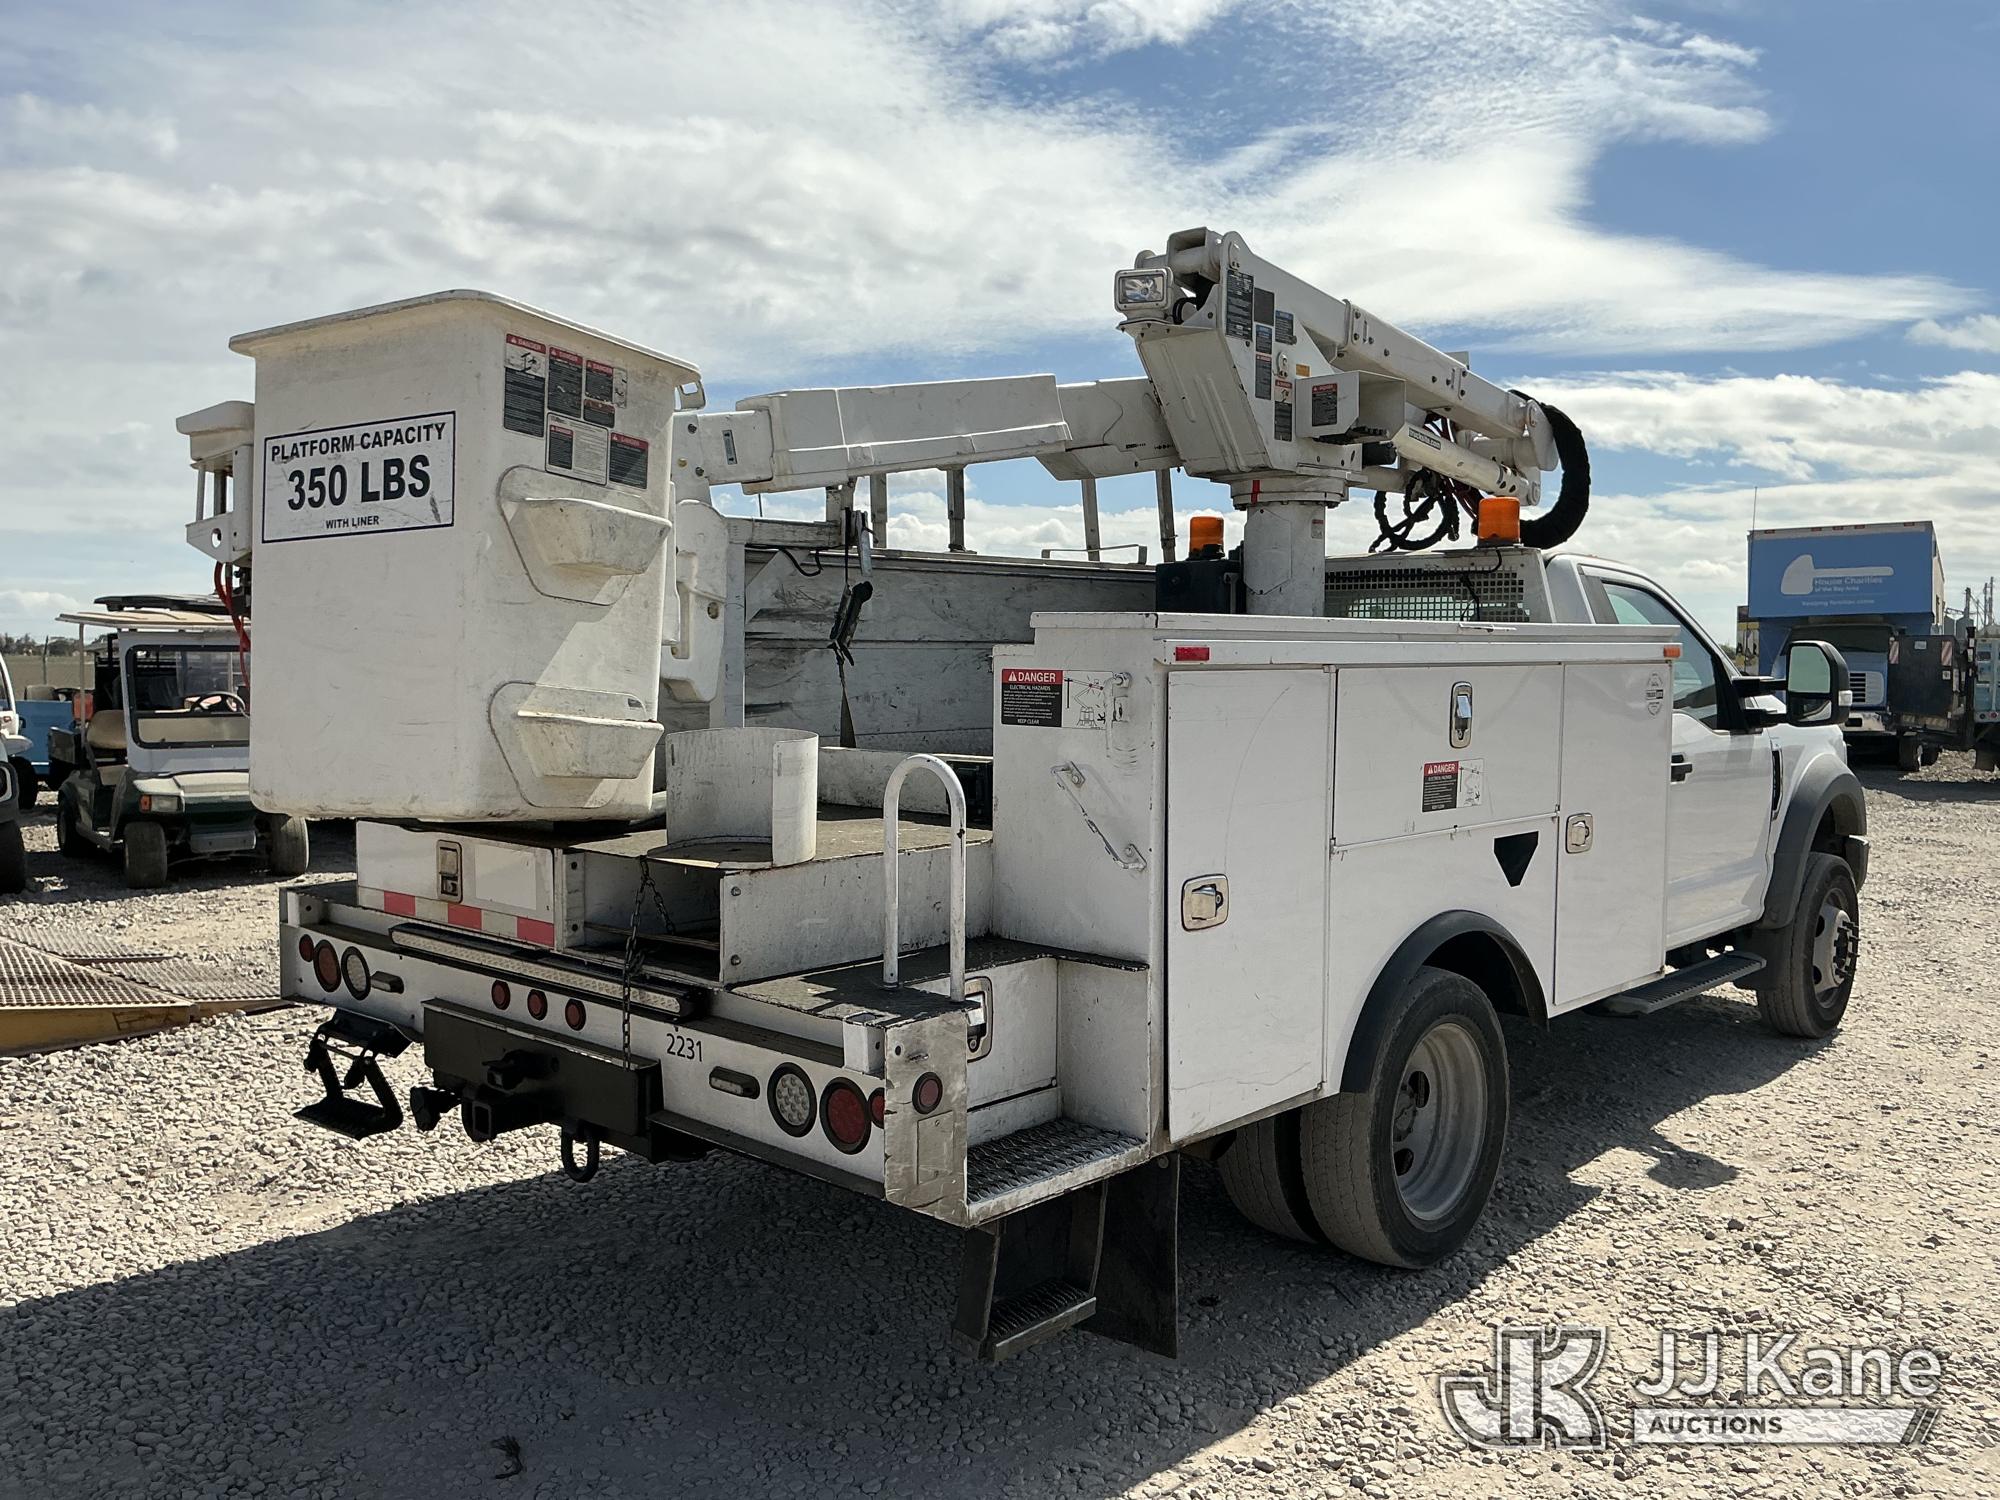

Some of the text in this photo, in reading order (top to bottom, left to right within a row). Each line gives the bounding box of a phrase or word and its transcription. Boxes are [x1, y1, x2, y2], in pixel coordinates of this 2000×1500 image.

[271, 422, 446, 461] PLATFORM CAPACITY
[287, 454, 431, 510] 350 LBS
[326, 515, 379, 529] WITH LINER
[1018, 671, 1055, 682] DANGER
[1434, 763, 1455, 773] DANGER
[666, 1033, 702, 1062] 2231
